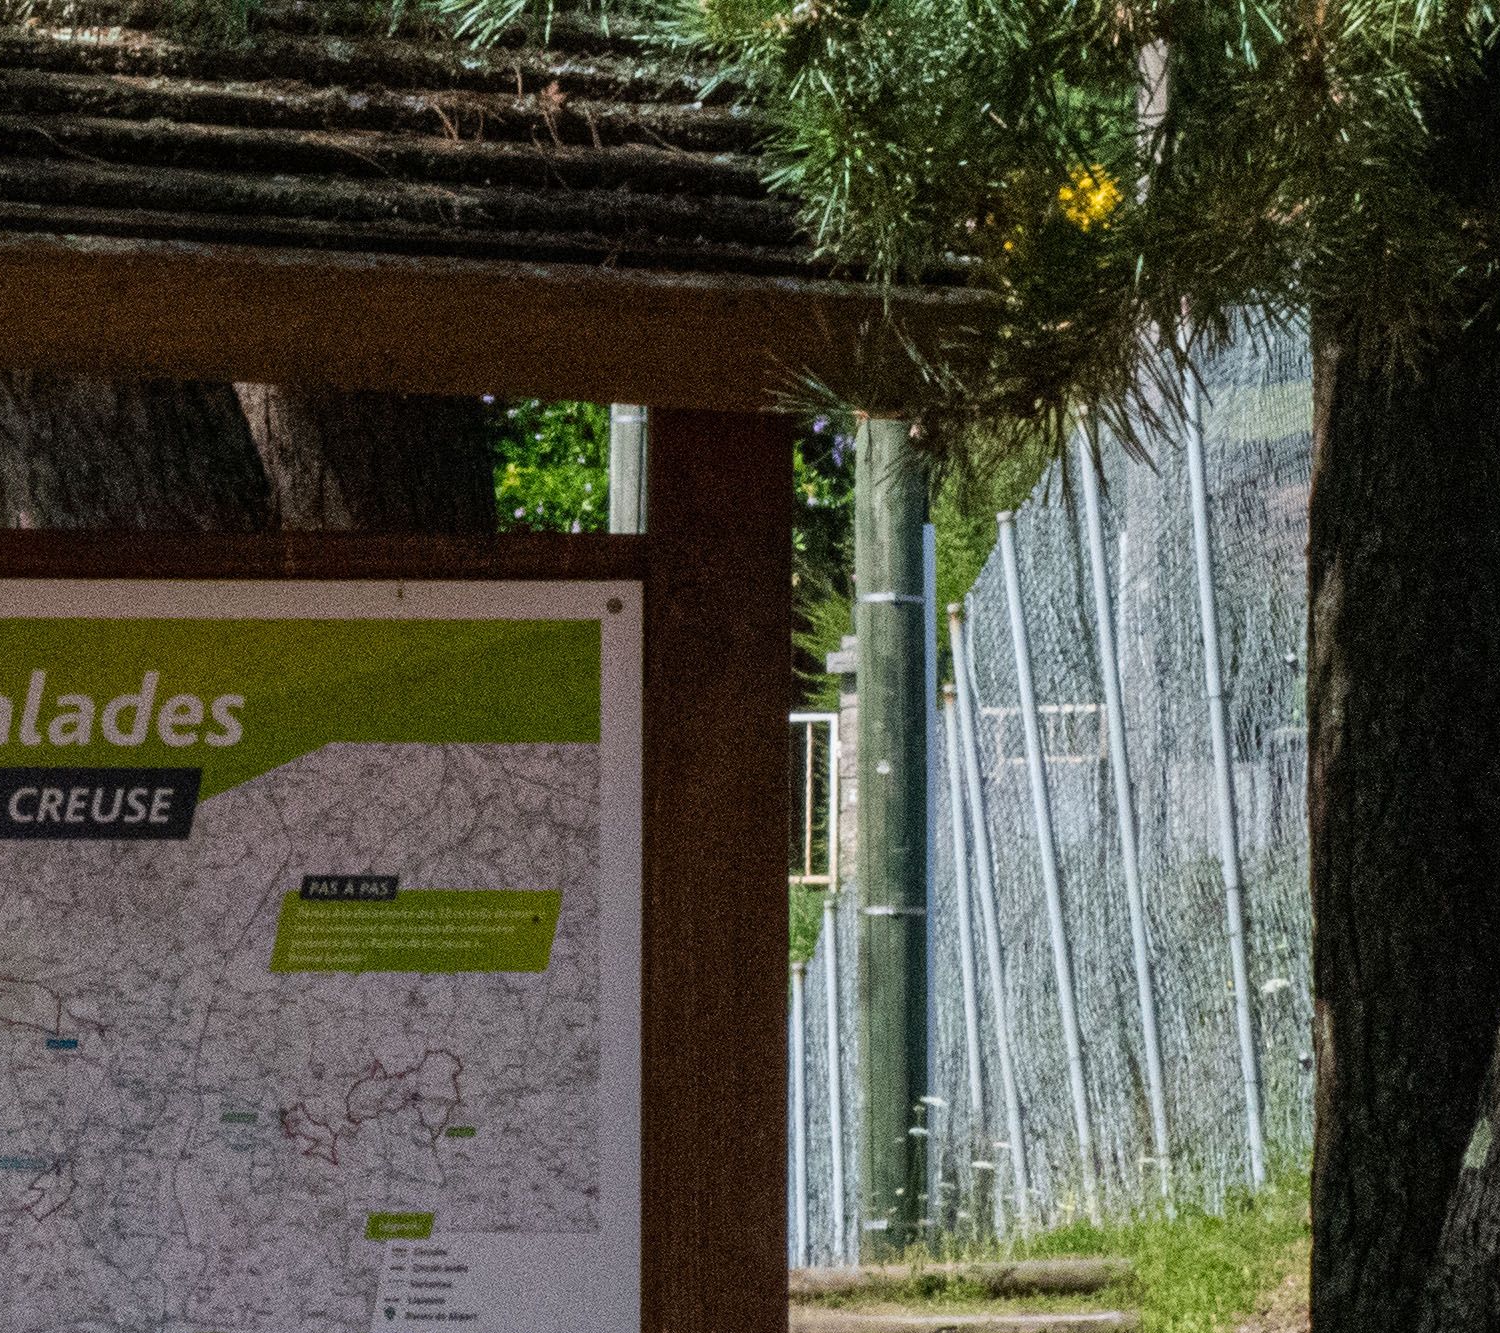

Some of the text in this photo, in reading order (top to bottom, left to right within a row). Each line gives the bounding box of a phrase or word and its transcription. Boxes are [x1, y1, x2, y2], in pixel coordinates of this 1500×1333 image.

[7, 785, 174, 825] CREUSE
[308, 880, 339, 896] PAS
[359, 880, 390, 896] PAS
